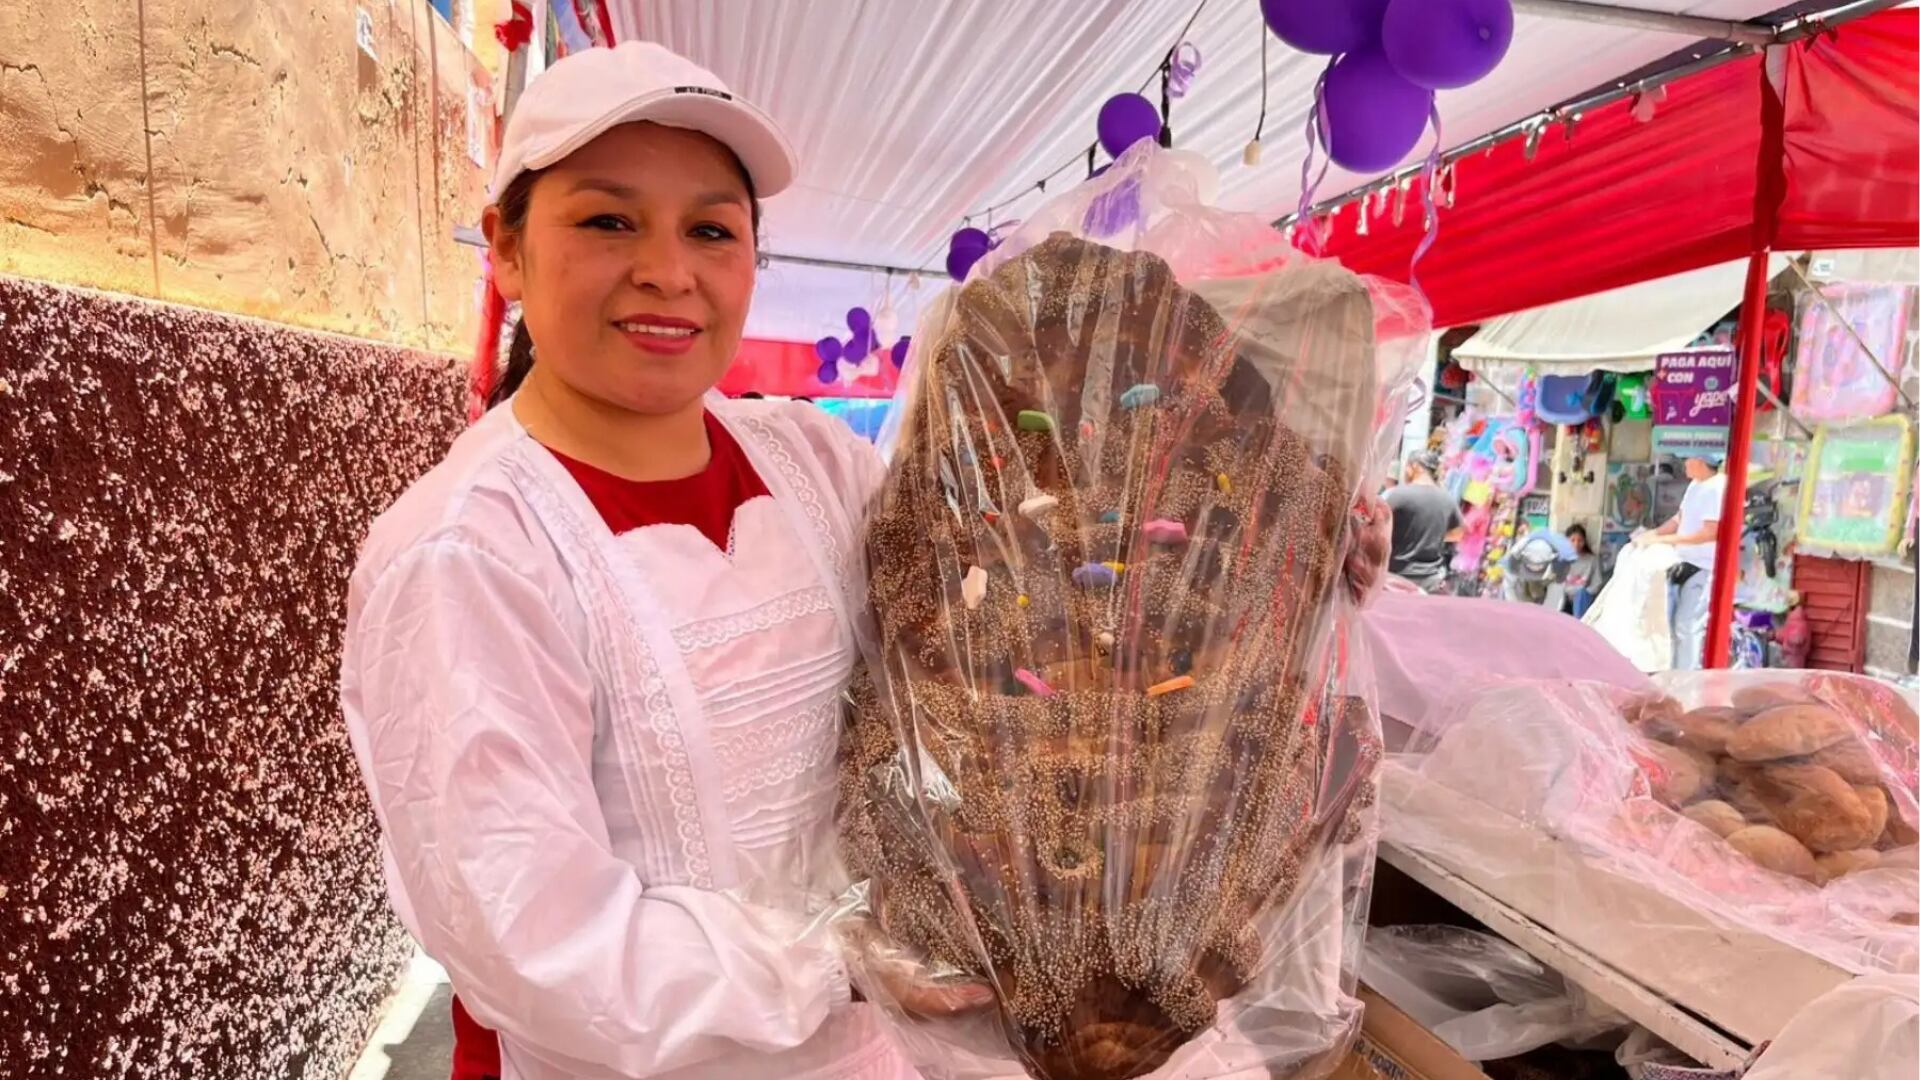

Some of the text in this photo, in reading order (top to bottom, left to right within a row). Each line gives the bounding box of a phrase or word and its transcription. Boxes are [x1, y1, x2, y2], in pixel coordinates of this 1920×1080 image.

[1661, 356, 1696, 368] PAGA
[1667, 372, 1694, 383] CON
[1689, 391, 1728, 417] yape
